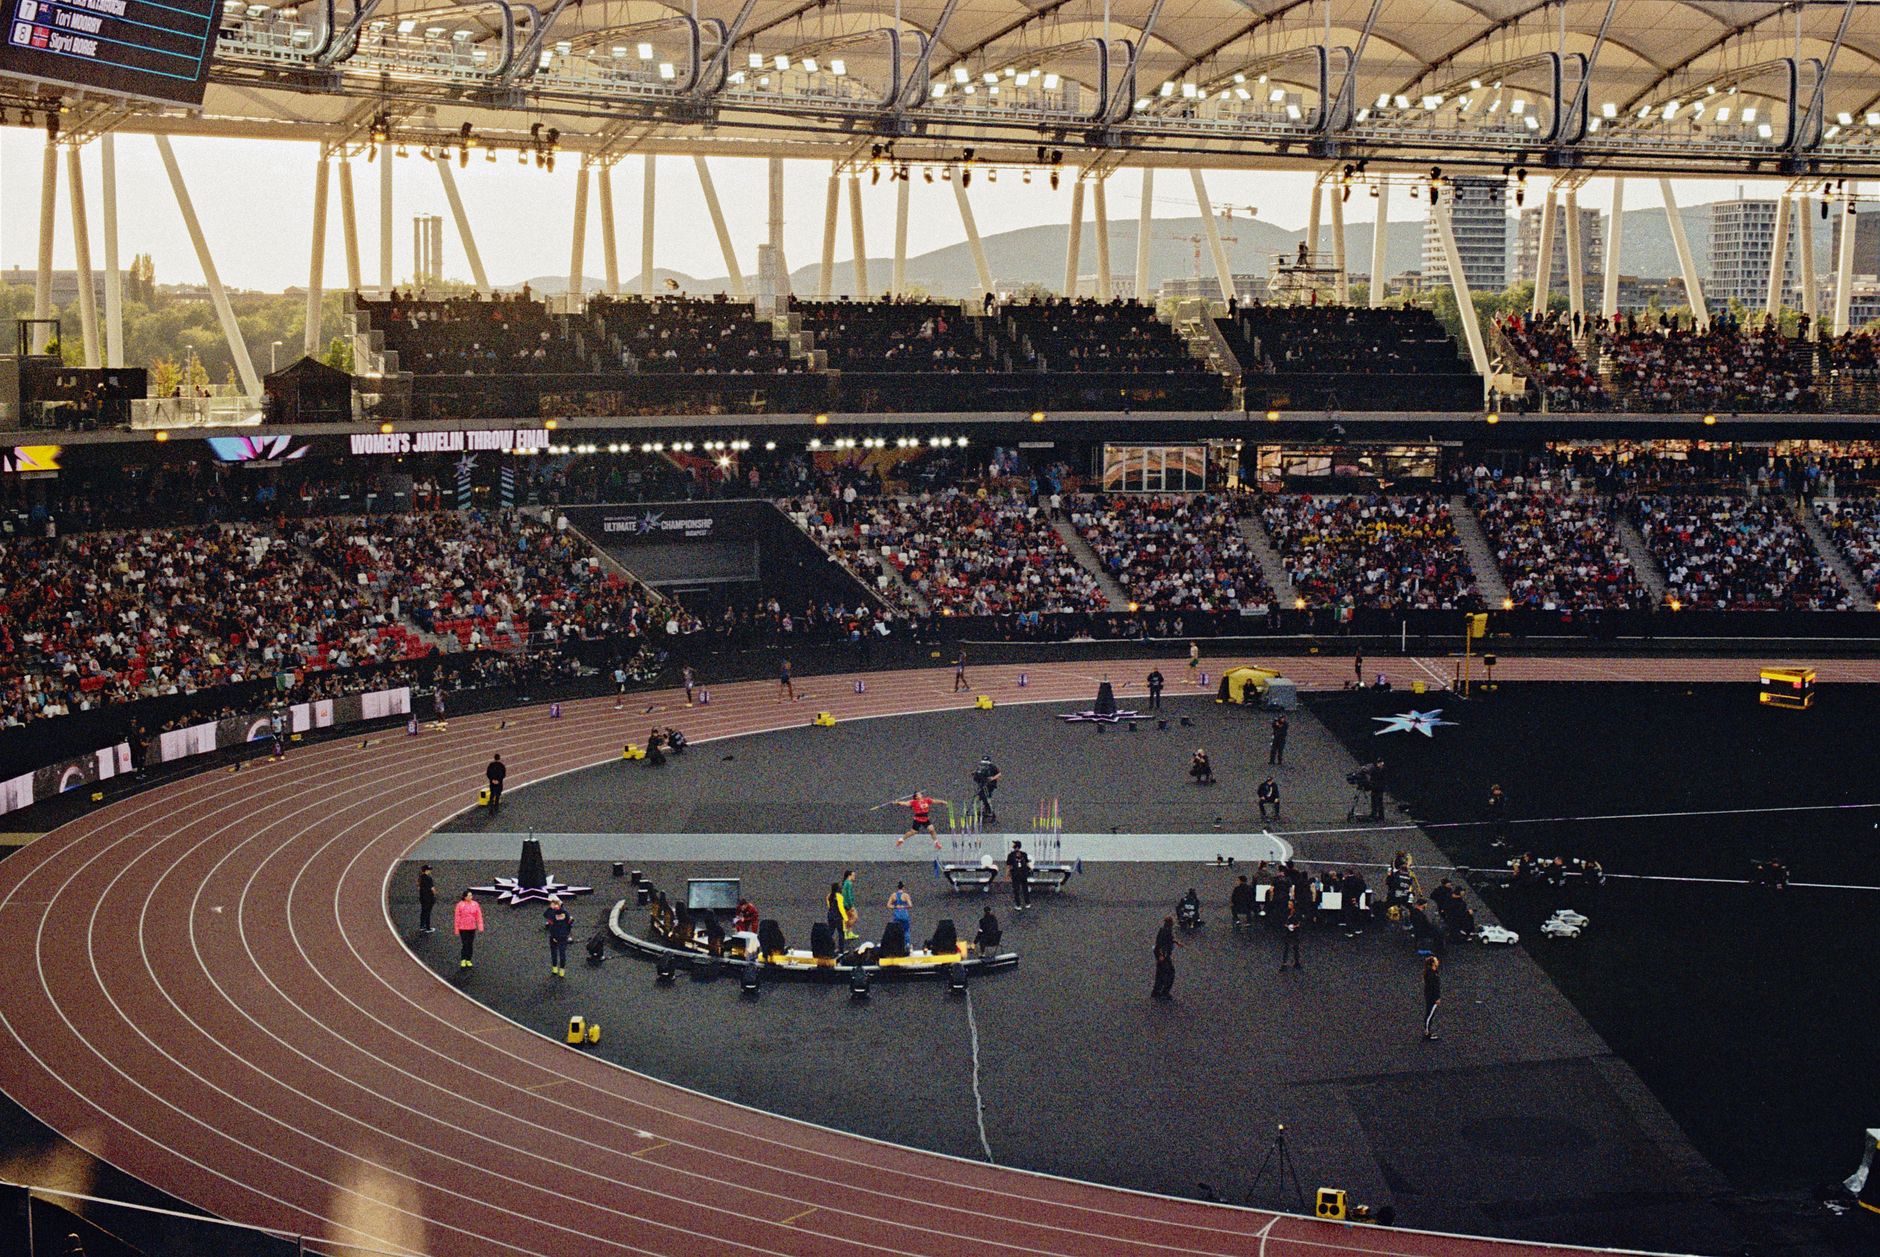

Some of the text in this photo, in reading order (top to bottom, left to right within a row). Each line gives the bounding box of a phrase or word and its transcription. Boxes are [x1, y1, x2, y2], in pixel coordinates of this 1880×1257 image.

[25, 3, 32, 17] 7
[55, 9, 72, 27] Tori
[19, 27, 98, 56] 8 Sigrid BORGE
[351, 429, 550, 454] WOMEN'S JAVELIN THROW FINAL
[604, 519, 713, 532] ULTIMATE CHAMPIONSHIP
